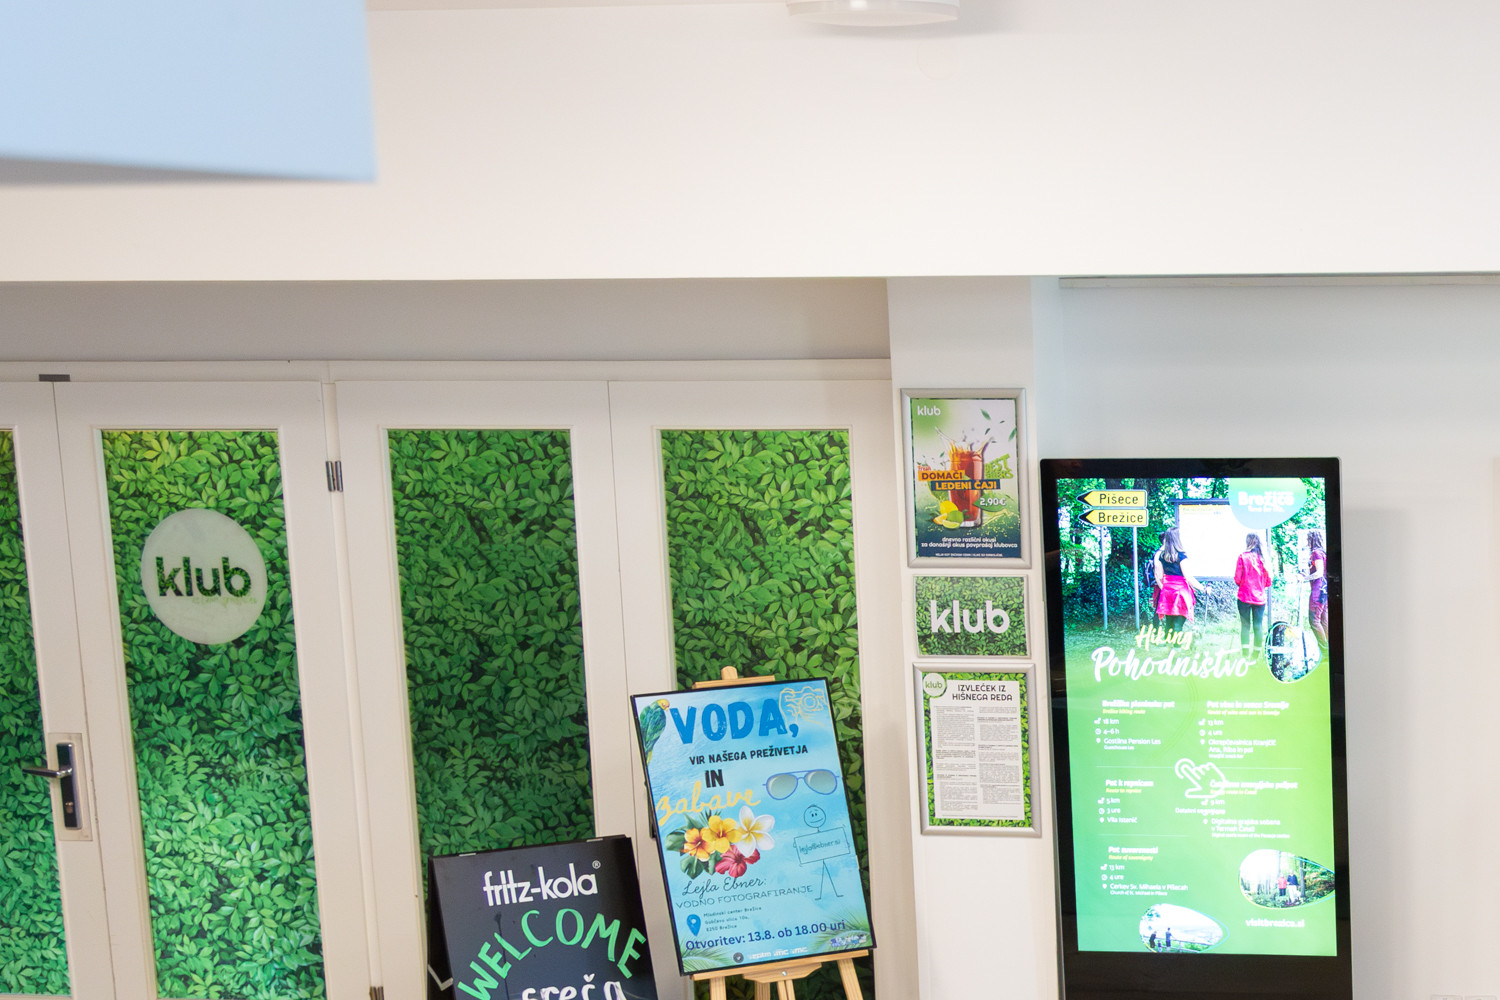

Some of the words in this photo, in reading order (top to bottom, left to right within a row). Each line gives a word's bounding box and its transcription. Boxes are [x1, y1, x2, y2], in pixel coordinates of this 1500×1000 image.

[917, 406, 941, 416] klub
[936, 482, 972, 490] LEDENI
[974, 481, 996, 489] ČAJI
[980, 498, 1006, 506] 2,90€
[1100, 494, 1138, 504] Pišece
[1098, 512, 1143, 522] Brežice
[156, 557, 251, 597] klub
[930, 600, 1010, 633] klub
[1136, 624, 1192, 651] Hiking
[1092, 646, 1256, 682] Pohodništvo
[952, 692, 988, 700] HIŠNEGA
[958, 683, 996, 692] IZVLEČEK
[670, 698, 798, 744] VODA,
[689, 756, 705, 765] VIR
[709, 751, 747, 763] NAŠEGA
[750, 744, 808, 760] PREŽIVETJA
[705, 769, 724, 788] IN
[656, 780, 761, 826] zabave
[676, 898, 715, 909] VODNO
[718, 885, 813, 903] FOTOGRAFIRANJE
[682, 879, 719, 899] Lejla
[686, 936, 745, 950] Otvoritev:
[747, 931, 775, 942] 13.8.
[777, 927, 792, 938] ob
[795, 922, 827, 936] 18.00
[830, 920, 846, 931] uri
